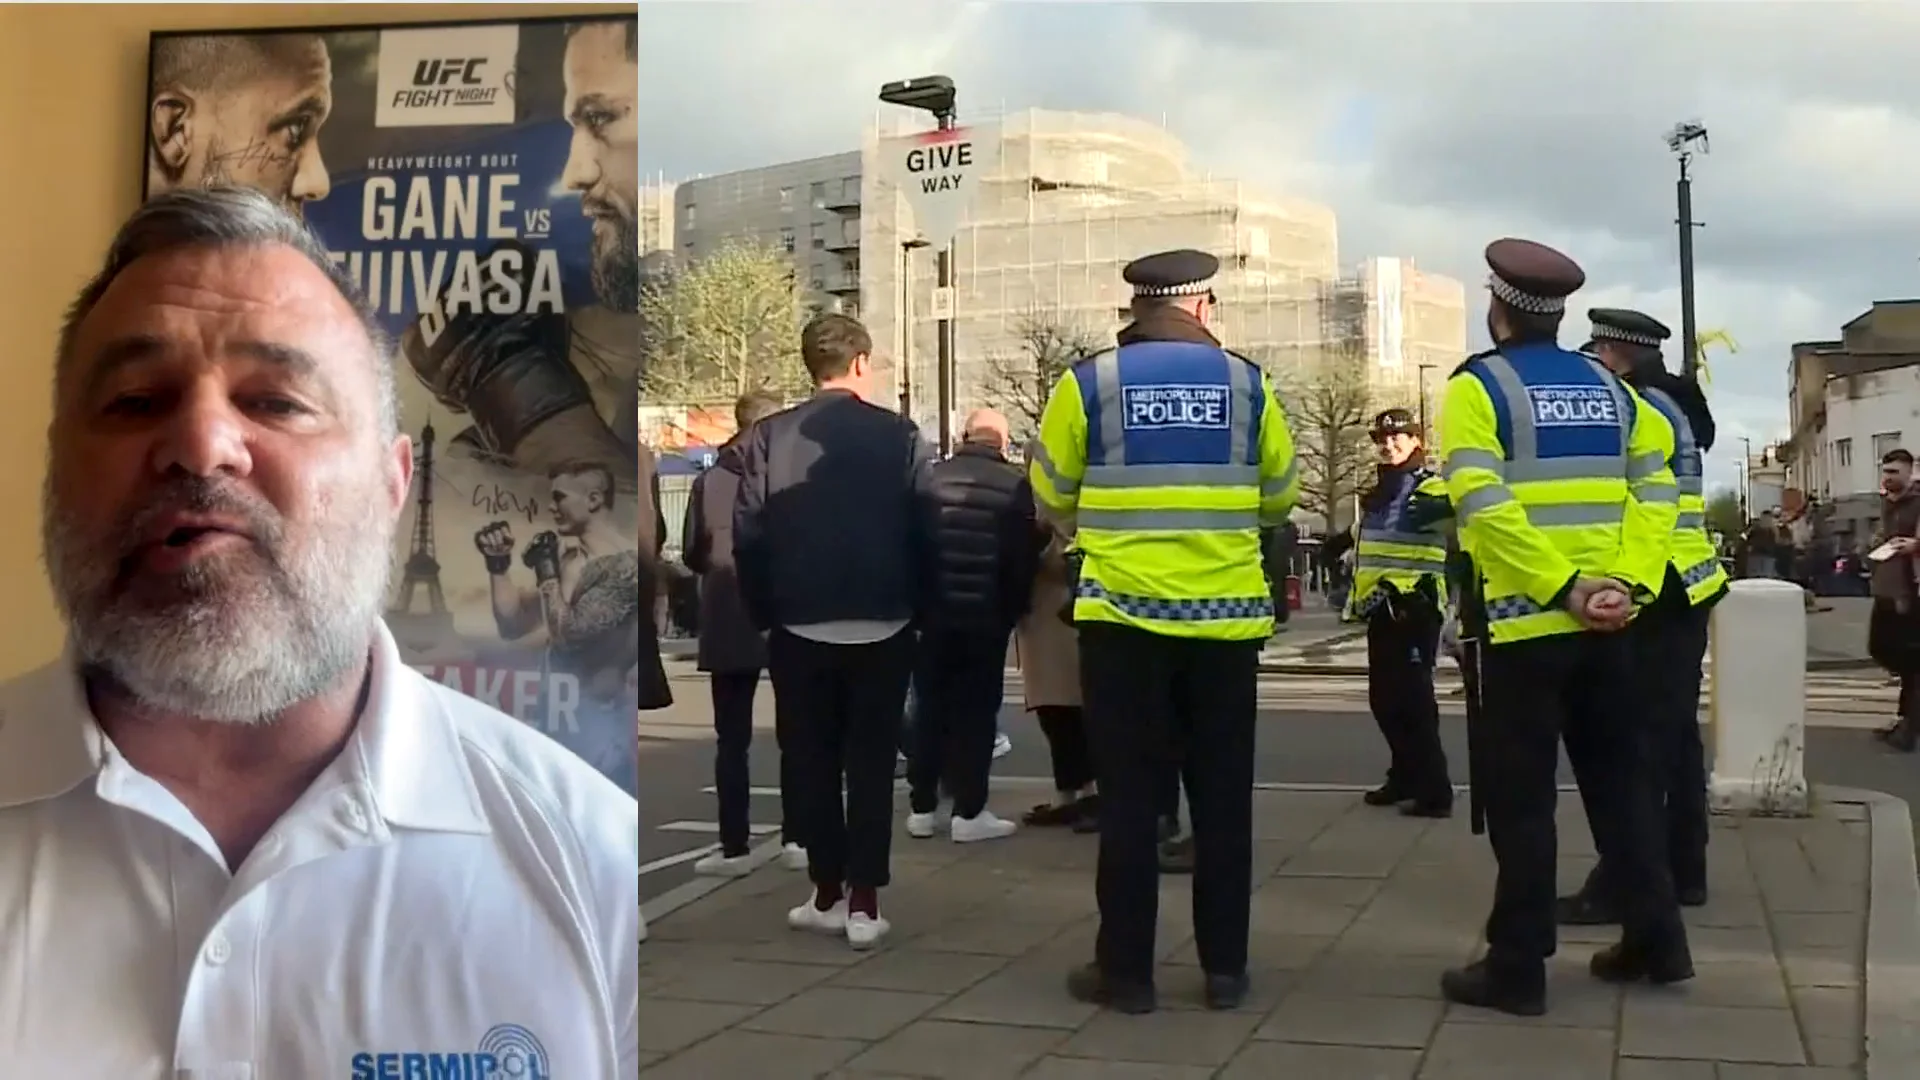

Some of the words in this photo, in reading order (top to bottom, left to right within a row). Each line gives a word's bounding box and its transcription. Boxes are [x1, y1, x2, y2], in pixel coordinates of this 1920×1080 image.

[413, 58, 487, 85] UFC
[392, 89, 454, 108] FIGHT
[455, 87, 499, 101] NIGHT
[368, 155, 471, 169] HEAVYWEIGHT
[481, 154, 518, 167] BOUT
[907, 143, 972, 172] GIVE
[922, 174, 962, 194] WAY
[362, 174, 521, 240] GANE
[525, 209, 551, 233] VS
[1131, 389, 1221, 401] METROPOLITAN
[1132, 402, 1221, 423] POLICE
[1538, 401, 1616, 420] POLICE
[418, 664, 580, 734] KER
